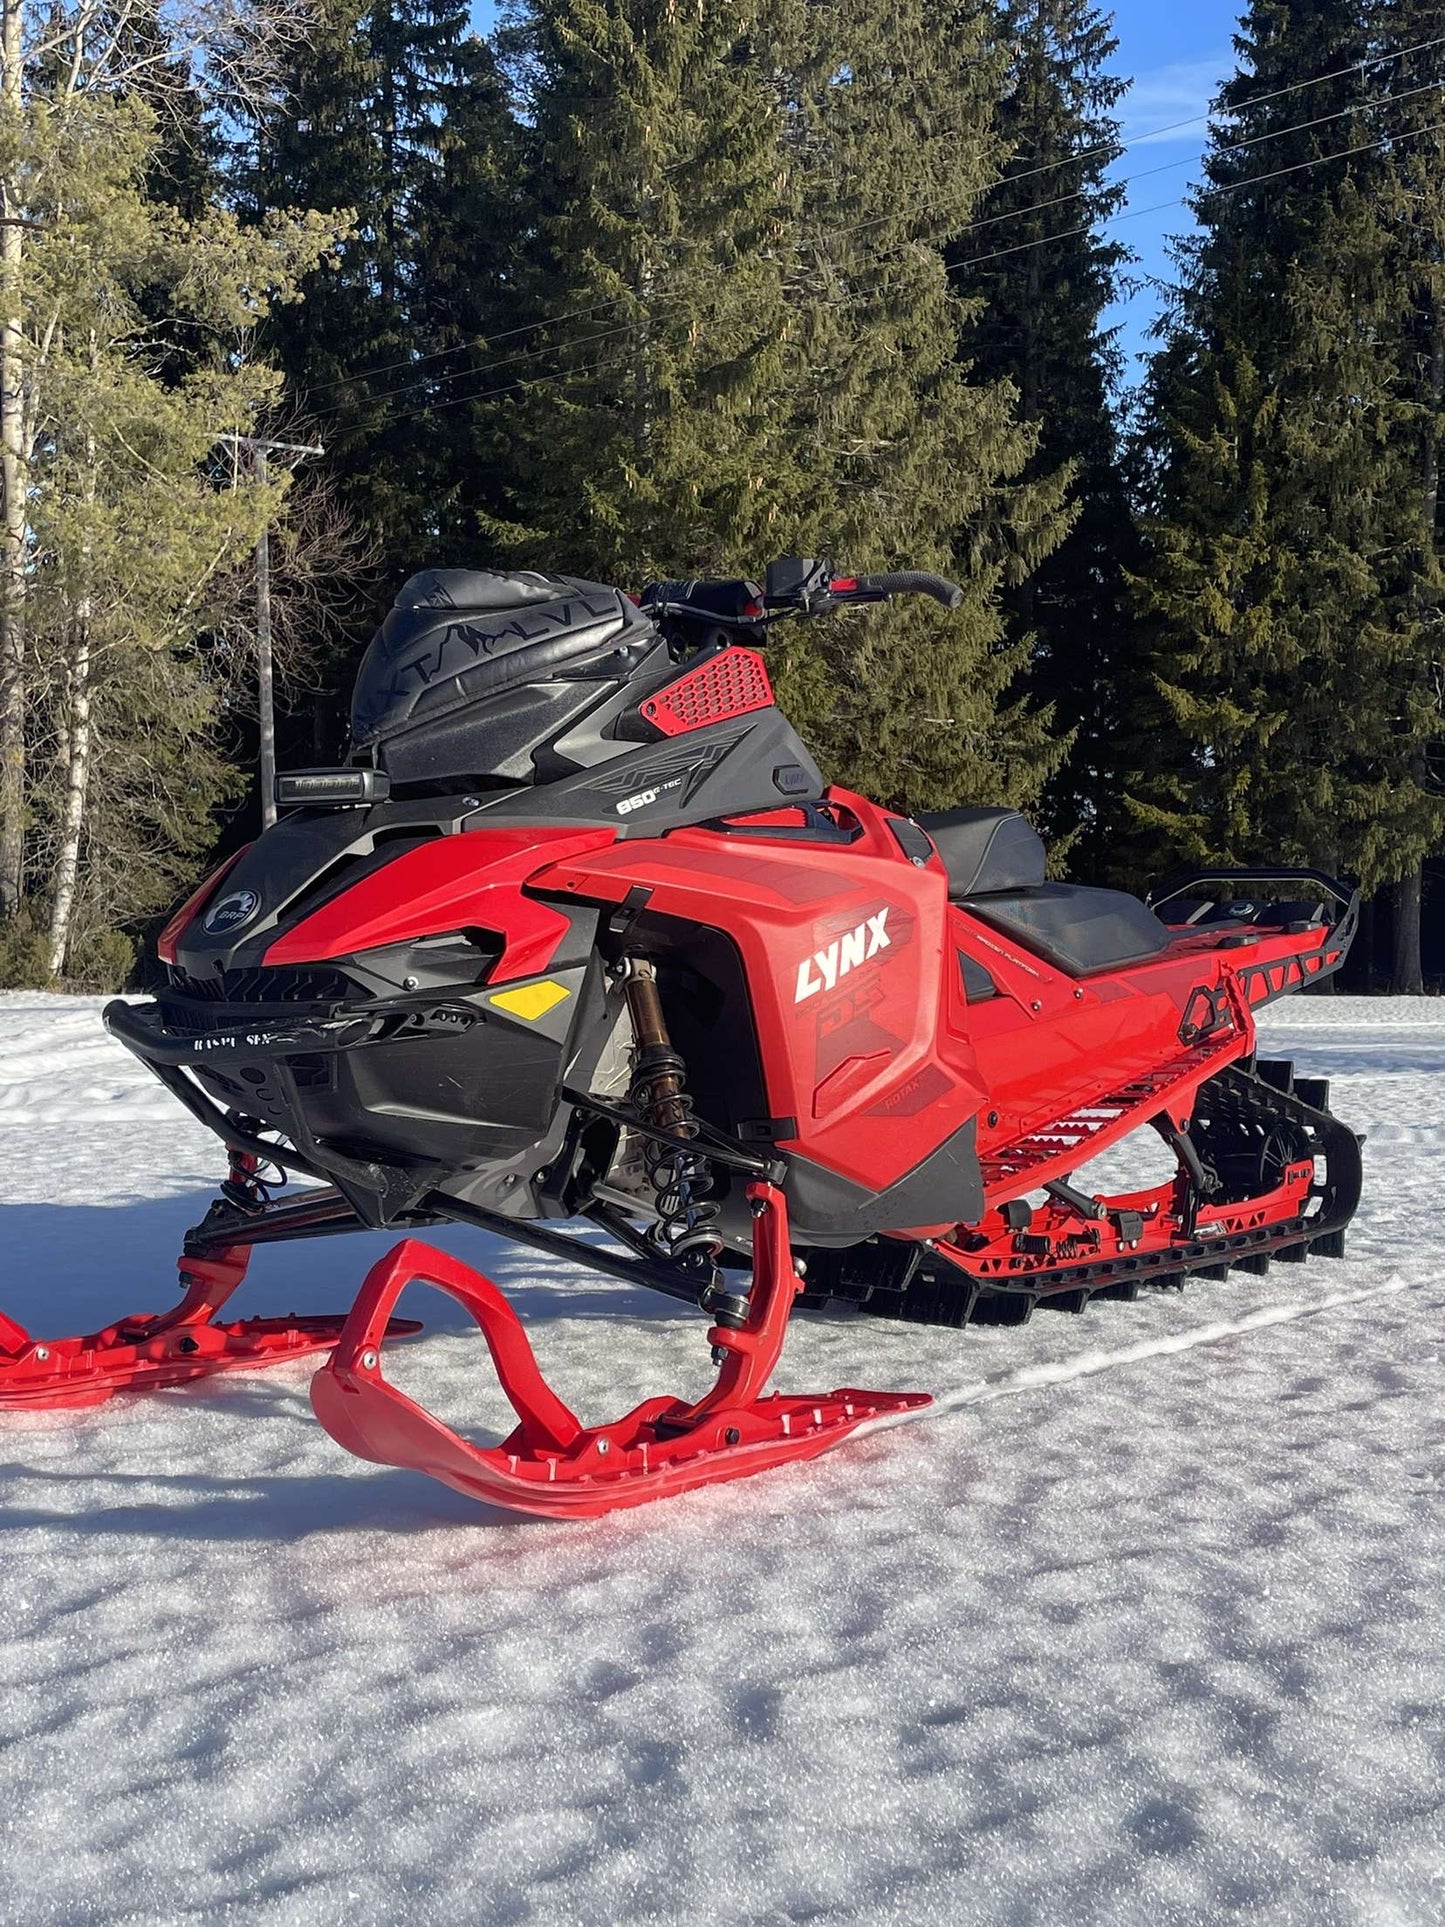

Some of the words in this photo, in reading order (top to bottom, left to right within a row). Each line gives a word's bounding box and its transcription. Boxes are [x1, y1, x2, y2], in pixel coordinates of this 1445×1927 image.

[616, 790, 656, 815] 850
[218, 911, 245, 920] BRP
[793, 906, 891, 1004] LYNX
[884, 1079, 920, 1110] ROTAX
